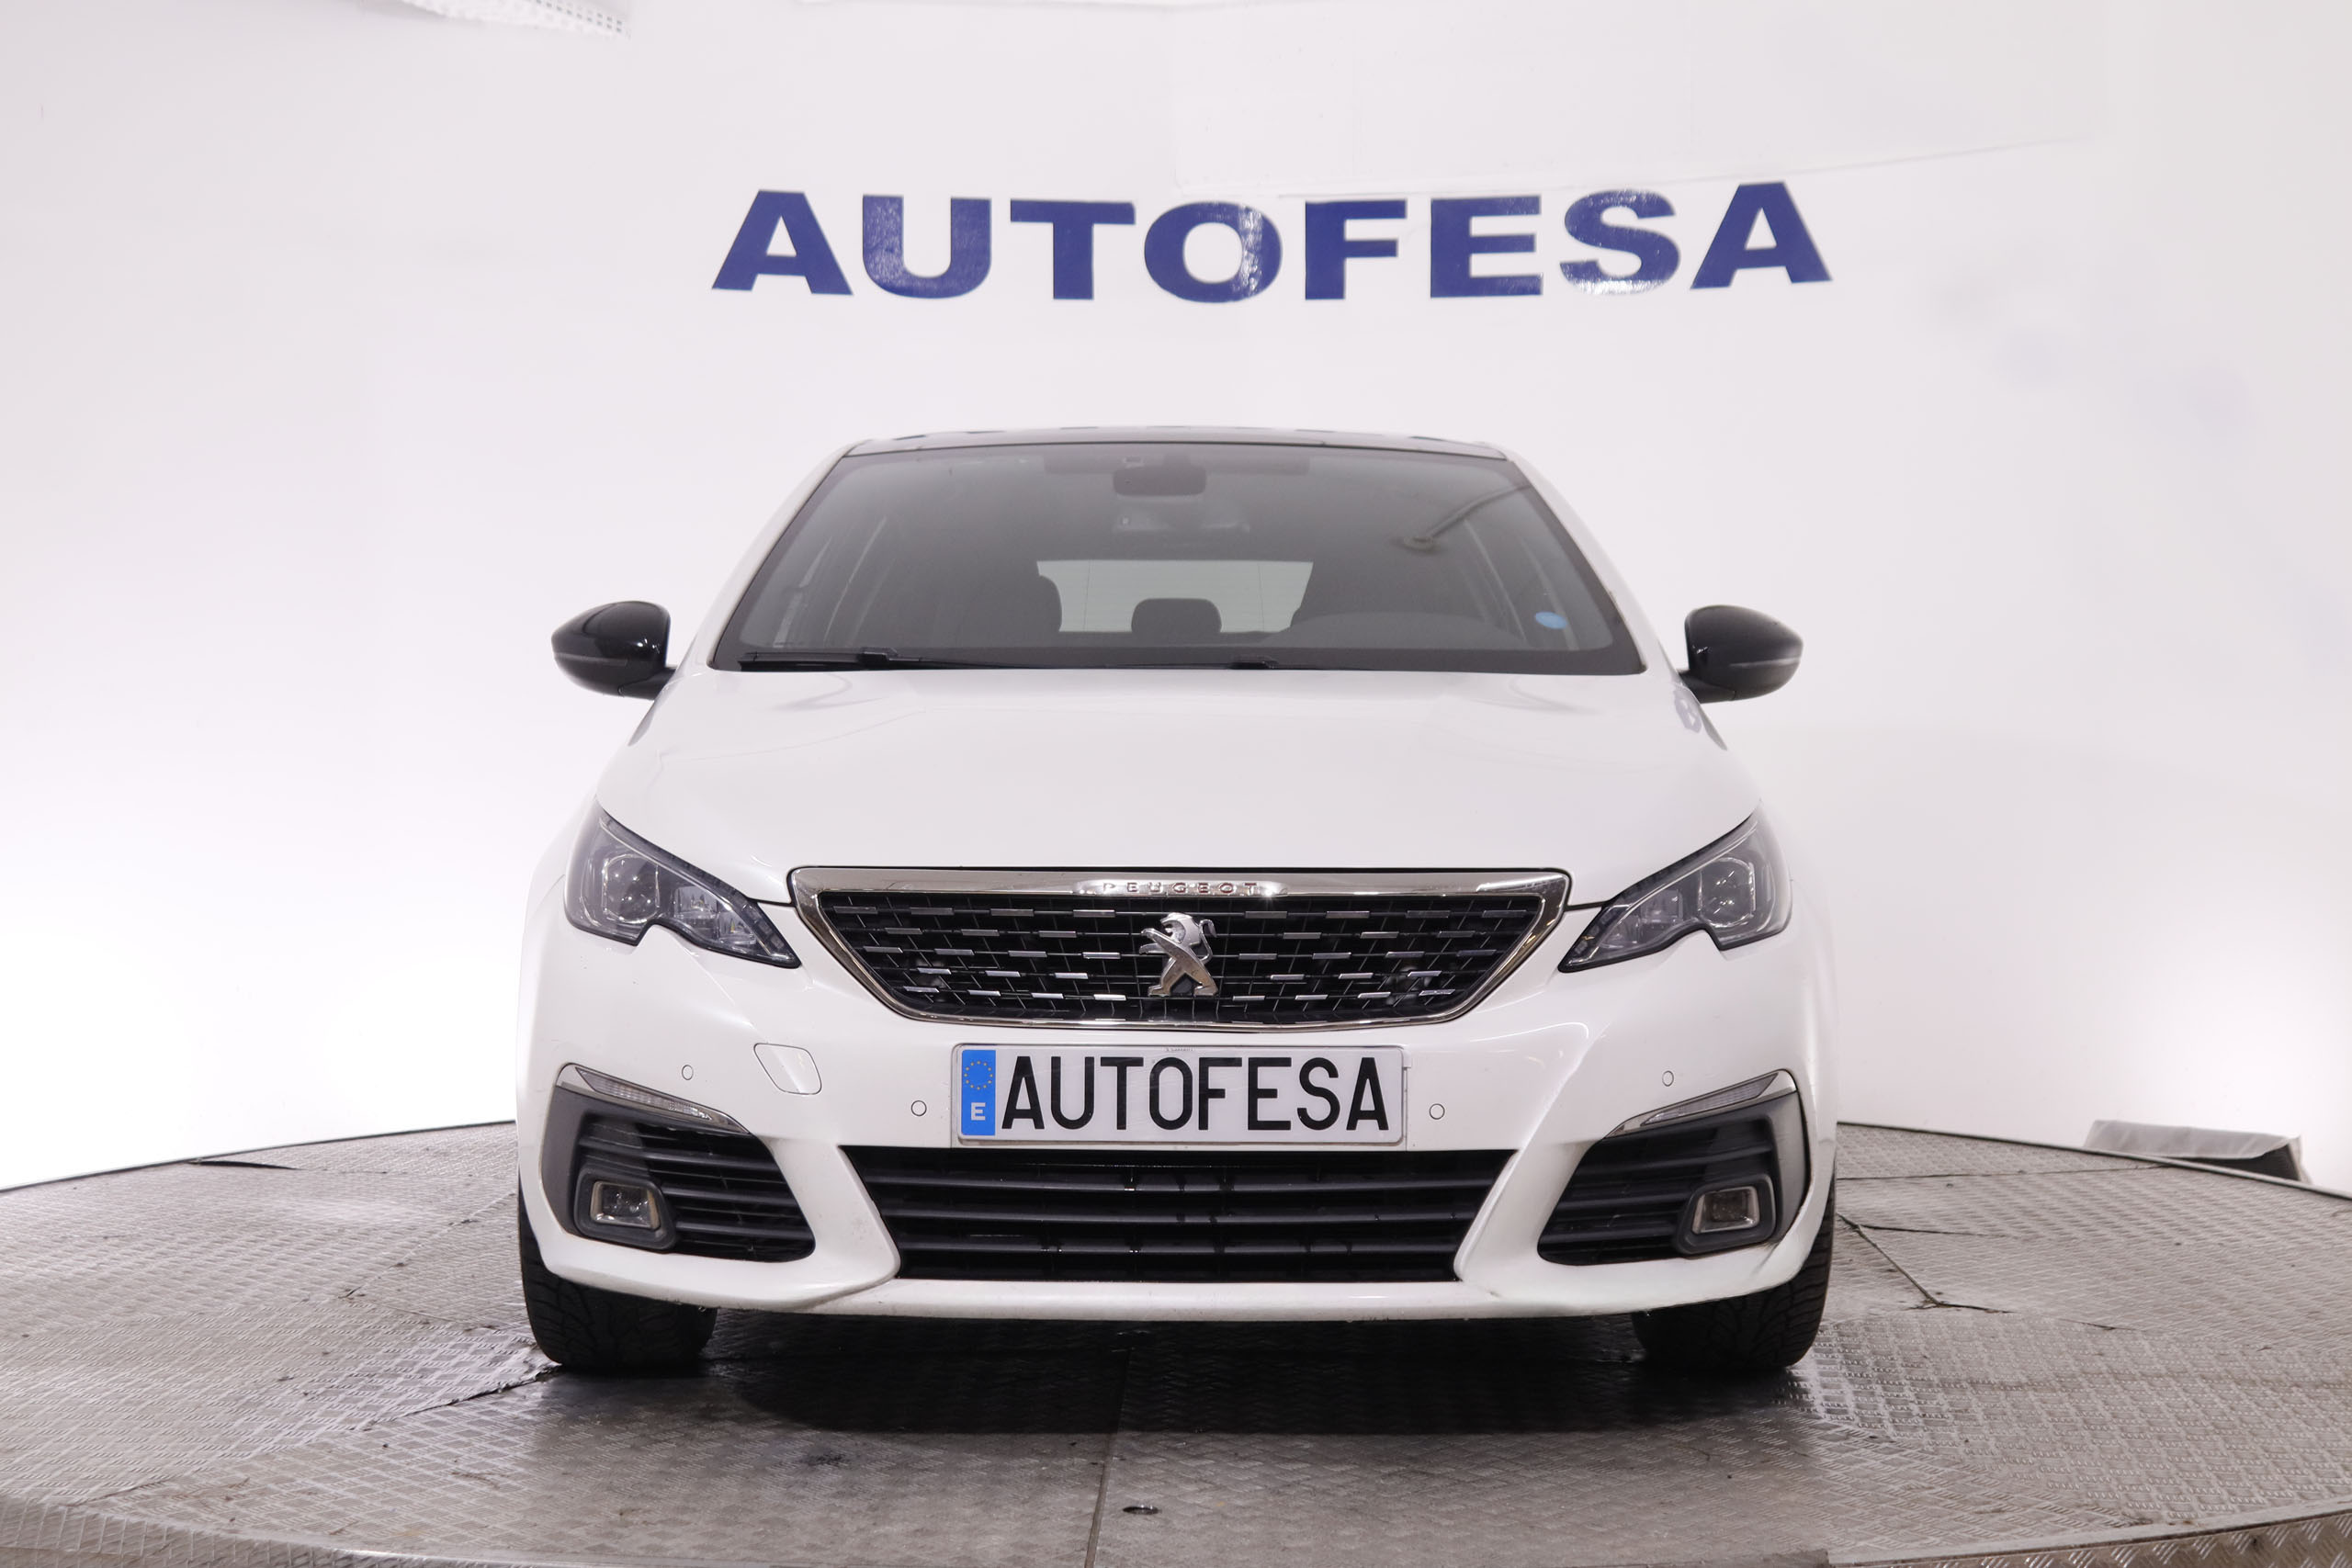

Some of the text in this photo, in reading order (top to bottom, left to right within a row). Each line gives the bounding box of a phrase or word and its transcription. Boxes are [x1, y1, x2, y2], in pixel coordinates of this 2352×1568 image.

[712, 182, 1830, 303] AUTOFESA
[1102, 882, 1258, 895] PEUGEOT
[970, 1102, 986, 1121] E
[1001, 1056, 1389, 1130] AUTOFESA
